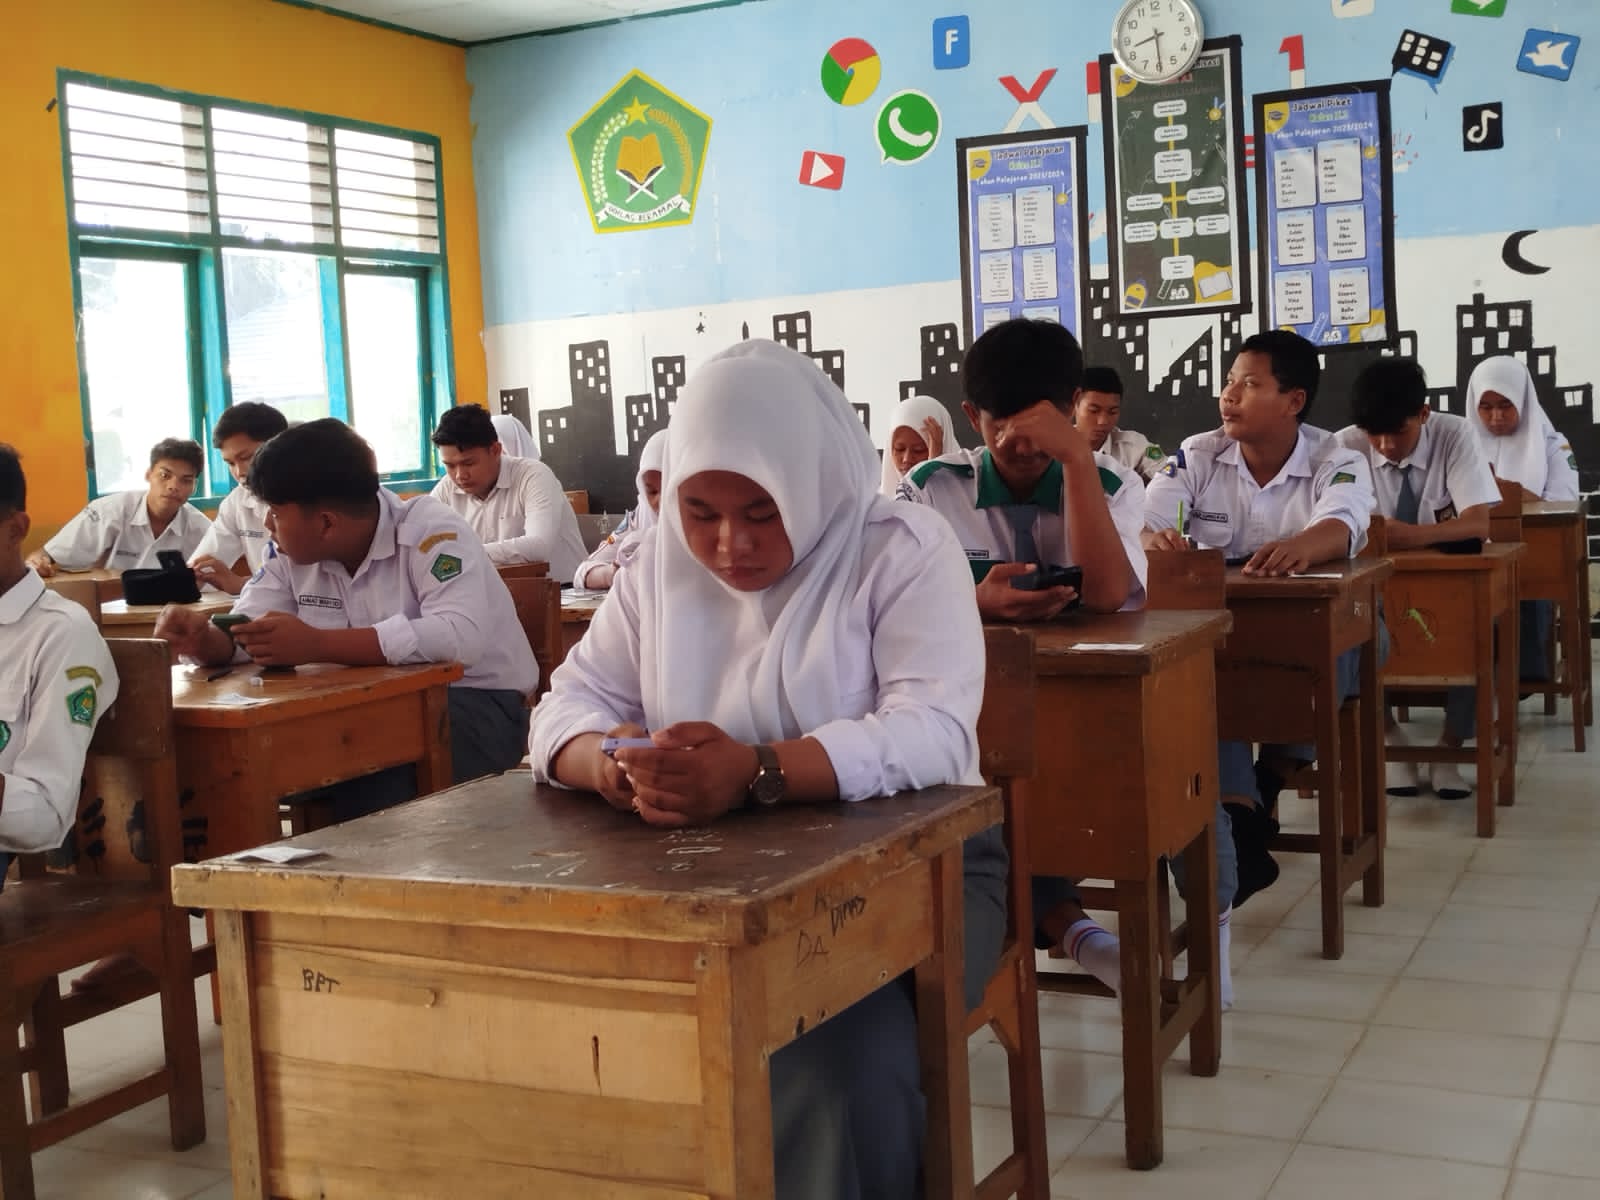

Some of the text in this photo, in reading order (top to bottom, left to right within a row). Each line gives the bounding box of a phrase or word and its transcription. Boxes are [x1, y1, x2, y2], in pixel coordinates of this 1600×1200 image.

[1150, 1, 1160, 10] 12
[1169, 3, 1173, 13] 1
[1138, 8, 1145, 18] 11
[1178, 12, 1185, 22] 2
[1128, 20, 1138, 30] 10
[1184, 26, 1191, 36] 3
[945, 29, 959, 55] F
[1124, 37, 1131, 47] 9
[1181, 42, 1187, 52] 4
[1130, 51, 1137, 61] 8
[1170, 56, 1177, 65] 5
[1142, 60, 1149, 70] 7
[1156, 63, 1163, 73] 6
[1292, 96, 1352, 112] Jadwal Piket
[302, 968, 341, 993] BPT
